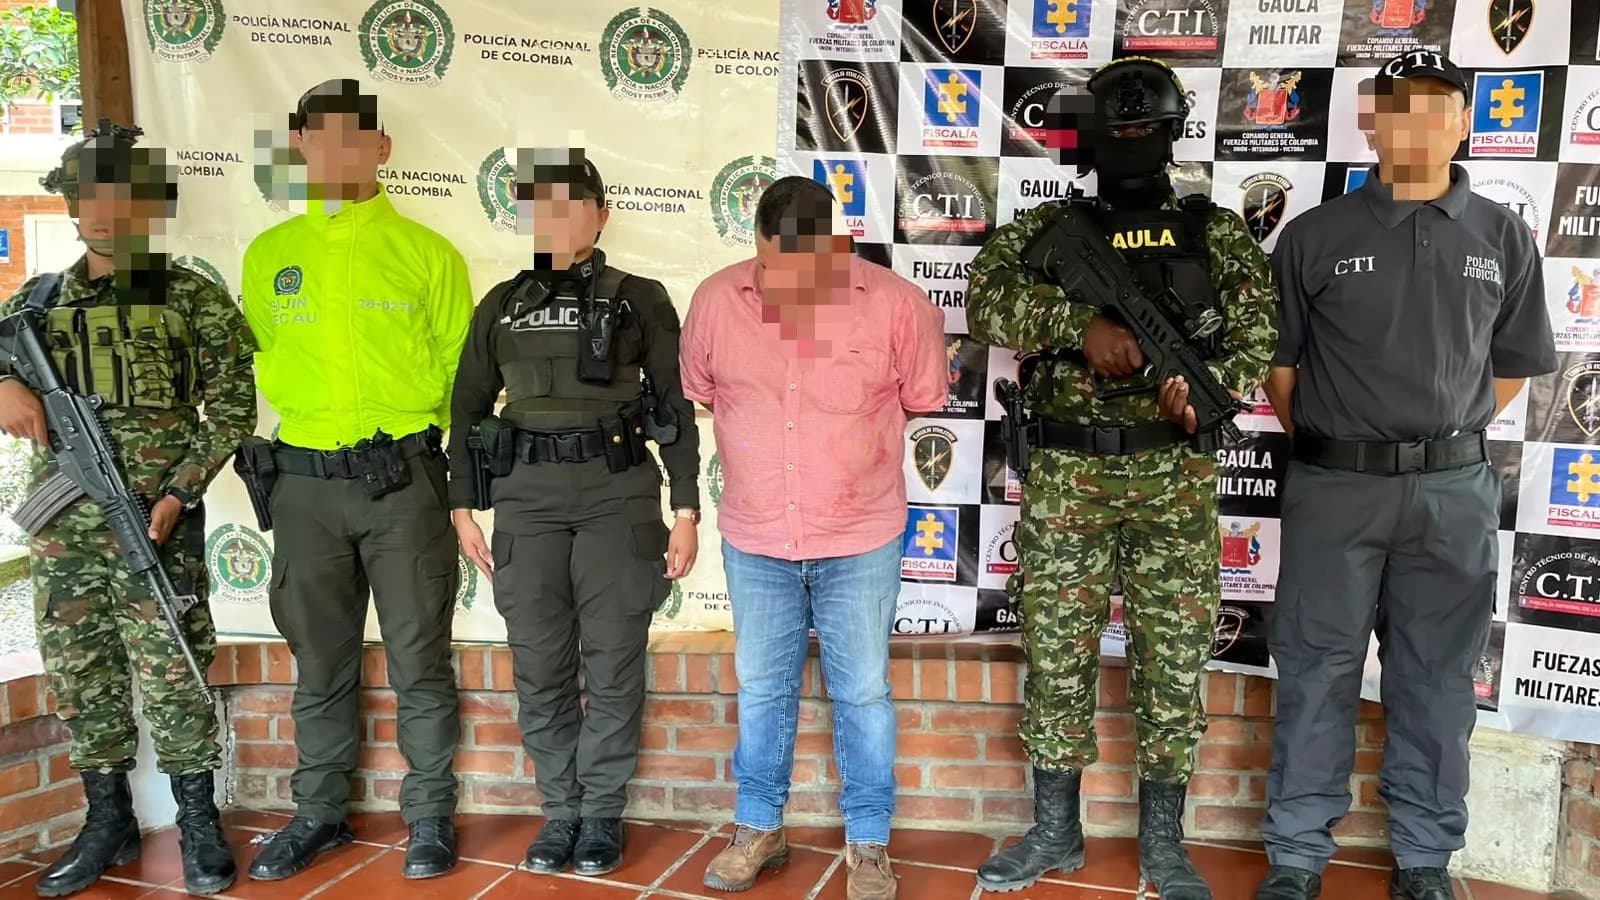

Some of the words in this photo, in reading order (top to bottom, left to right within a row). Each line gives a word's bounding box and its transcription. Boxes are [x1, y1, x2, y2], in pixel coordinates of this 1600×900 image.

[232, 14, 280, 28] POLICÍA
[282, 18, 351, 32] NACIONAL
[251, 32, 267, 42] DE
[268, 33, 332, 46] COLOMBIA
[464, 34, 517, 47] POLICÍA
[521, 38, 591, 52] NACIONAL
[1249, 25, 1322, 44] MILITAR
[1032, 39, 1088, 50] FISCALÍA
[481, 50, 498, 60] DE
[502, 51, 573, 66] COLOMBIA
[698, 48, 750, 60] POLICÍA
[715, 64, 732, 74] DE
[1385, 51, 1445, 76] CTI
[923, 128, 978, 138] FISCALÍA
[1472, 134, 1535, 144] FISCALÍA
[176, 151, 243, 162] NACIONAL
[402, 171, 467, 184] NACIONAL
[386, 184, 452, 197] COLOMBIA
[634, 186, 704, 200] NACIONAL
[1020, 179, 1074, 198] GAULA
[616, 200, 686, 213] COLOMBIA
[1112, 228, 1176, 249] AULA
[913, 261, 971, 280] FUEZAS
[1335, 256, 1376, 276] CTI
[1466, 255, 1500, 272] POLICÍA
[1463, 267, 1502, 285] JUDICIAL
[1216, 449, 1272, 469] GAULA
[1532, 650, 1600, 677] FUEZAS
[1515, 678, 1600, 707] MILITARE
